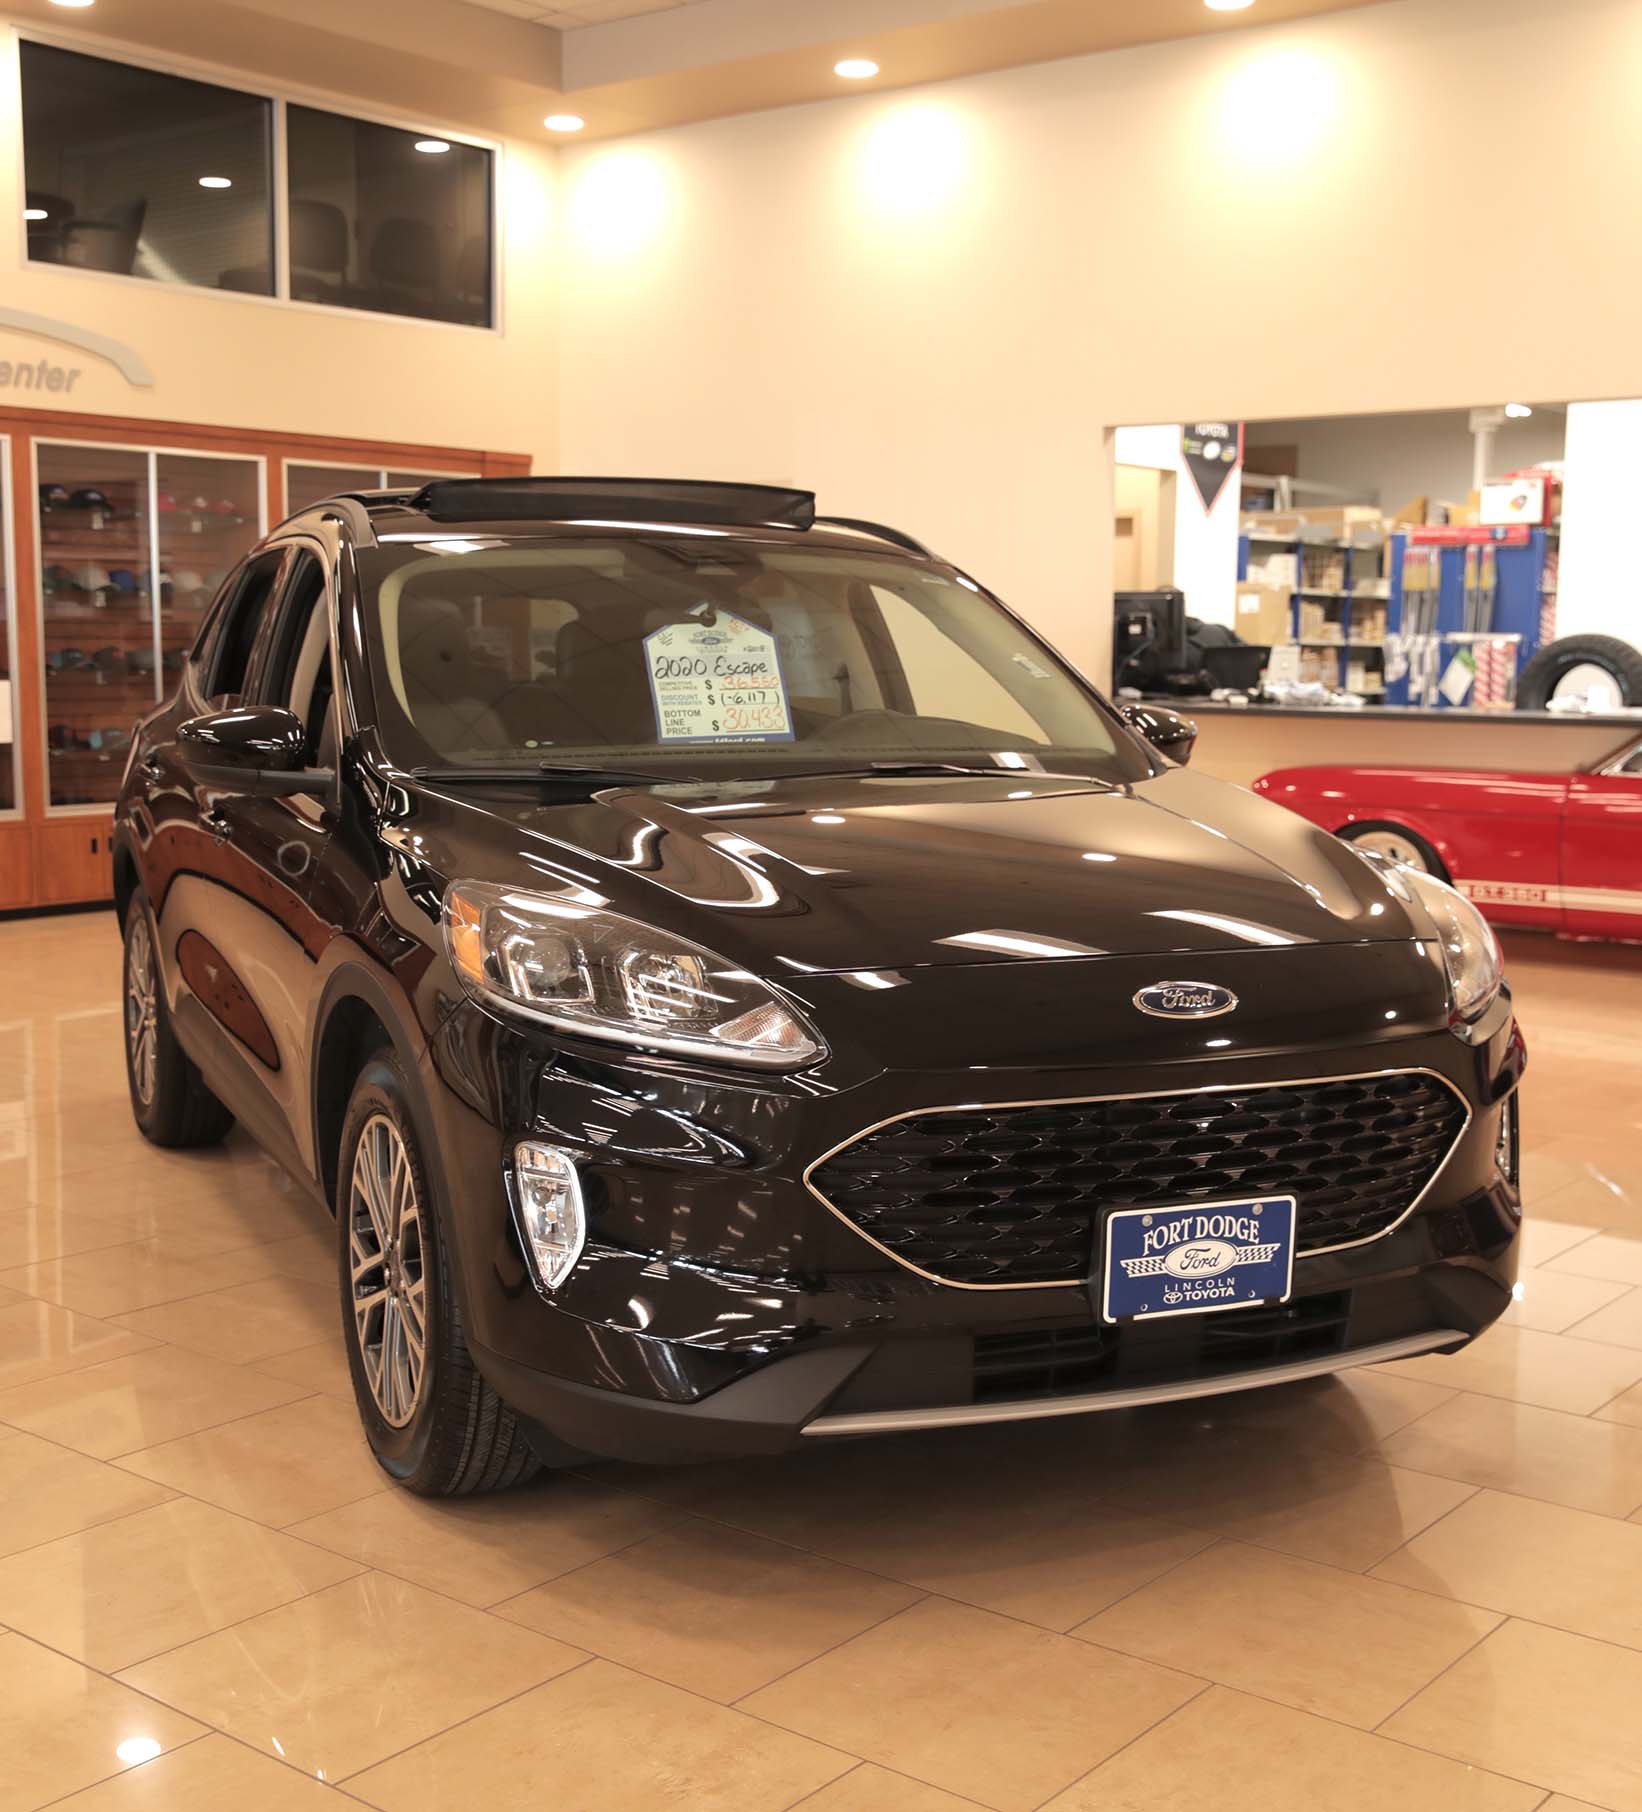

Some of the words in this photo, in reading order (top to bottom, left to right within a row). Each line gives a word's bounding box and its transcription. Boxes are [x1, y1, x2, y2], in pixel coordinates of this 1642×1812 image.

[655, 655, 707, 679] 2020
[714, 655, 768, 677] Escape
[705, 679, 712, 690] $
[707, 694, 715, 705] $
[665, 718, 685, 726] LINE
[712, 720, 720, 732] $
[666, 726, 693, 735] PRICE
[1161, 987, 1216, 1008] Ford
[1143, 1216, 1194, 1256] FORT
[1196, 1215, 1260, 1244] DODGE
[1180, 1248, 1221, 1270] Ford
[1164, 1277, 1236, 1293] LINCOLN
[1183, 1287, 1236, 1301] TOYOTA
